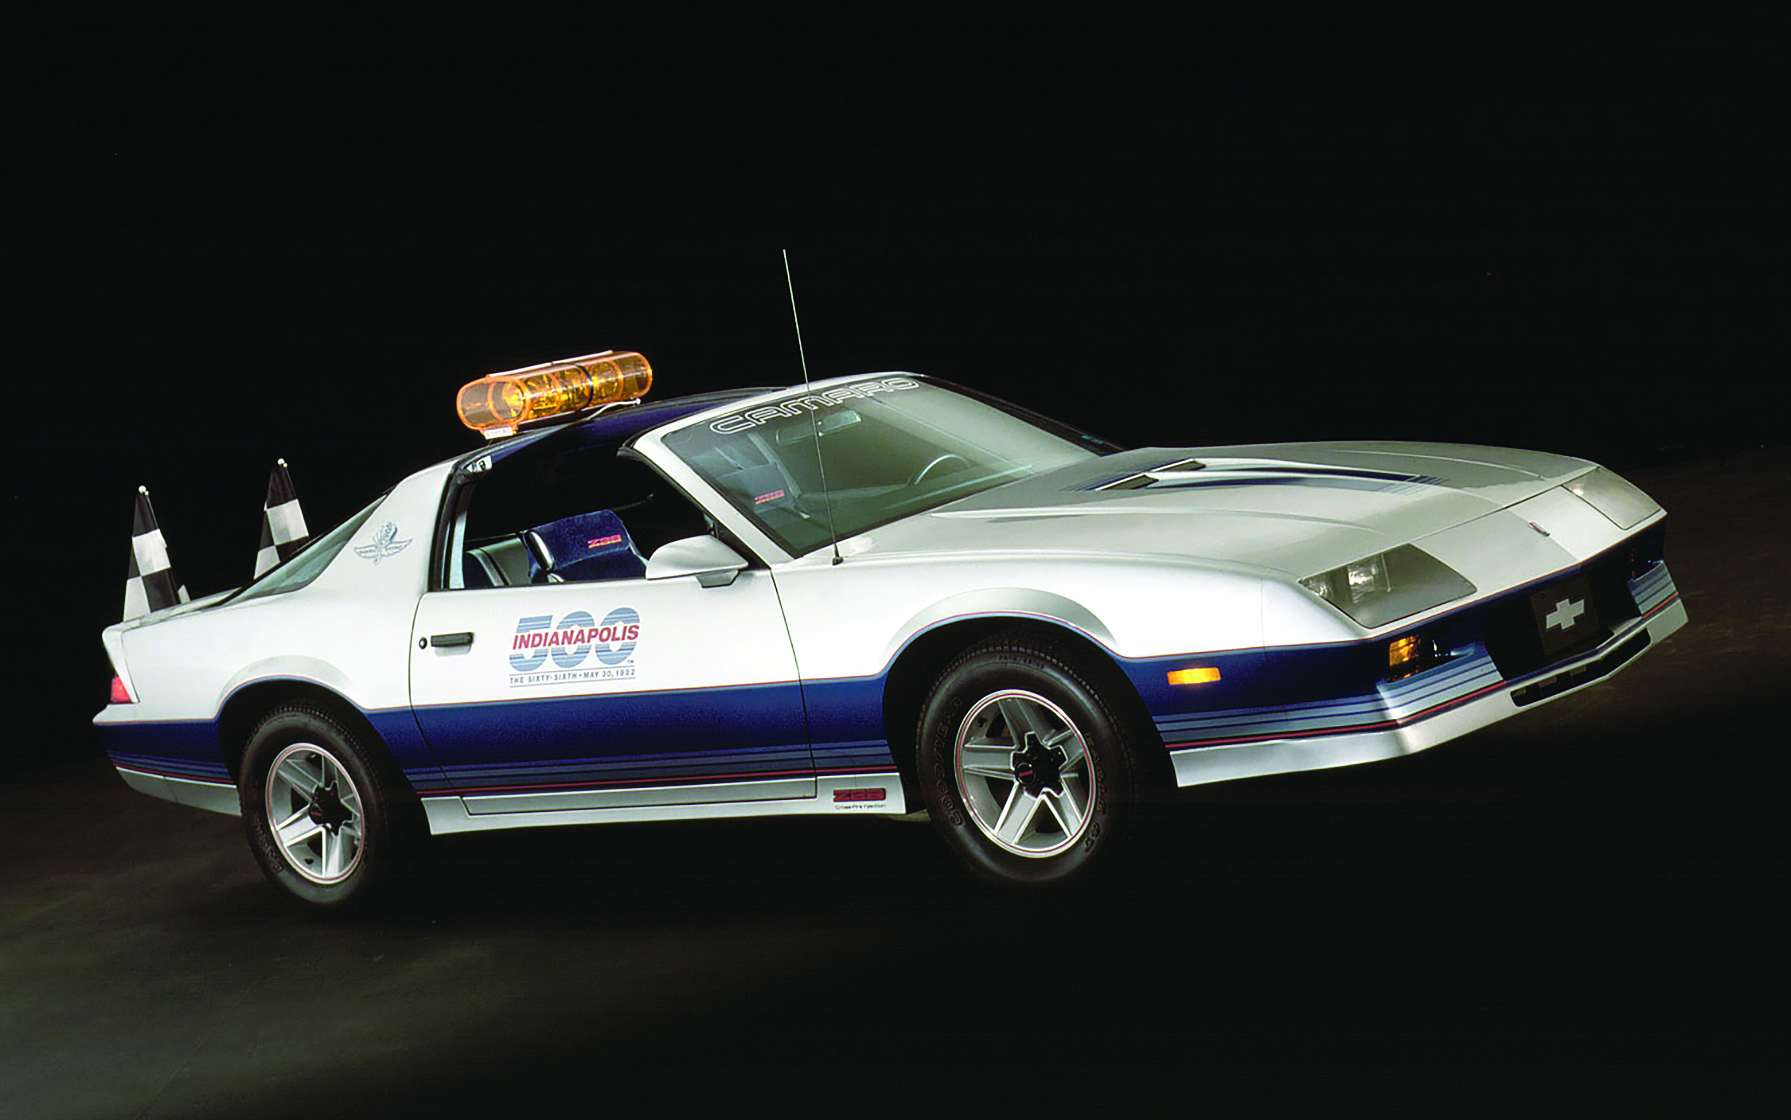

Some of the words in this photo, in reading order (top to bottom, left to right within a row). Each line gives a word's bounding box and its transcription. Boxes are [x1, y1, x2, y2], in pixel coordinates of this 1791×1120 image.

[710, 377, 919, 434] CAMARO
[509, 607, 640, 671] 500
[512, 624, 640, 650] INDIANAPOLIS
